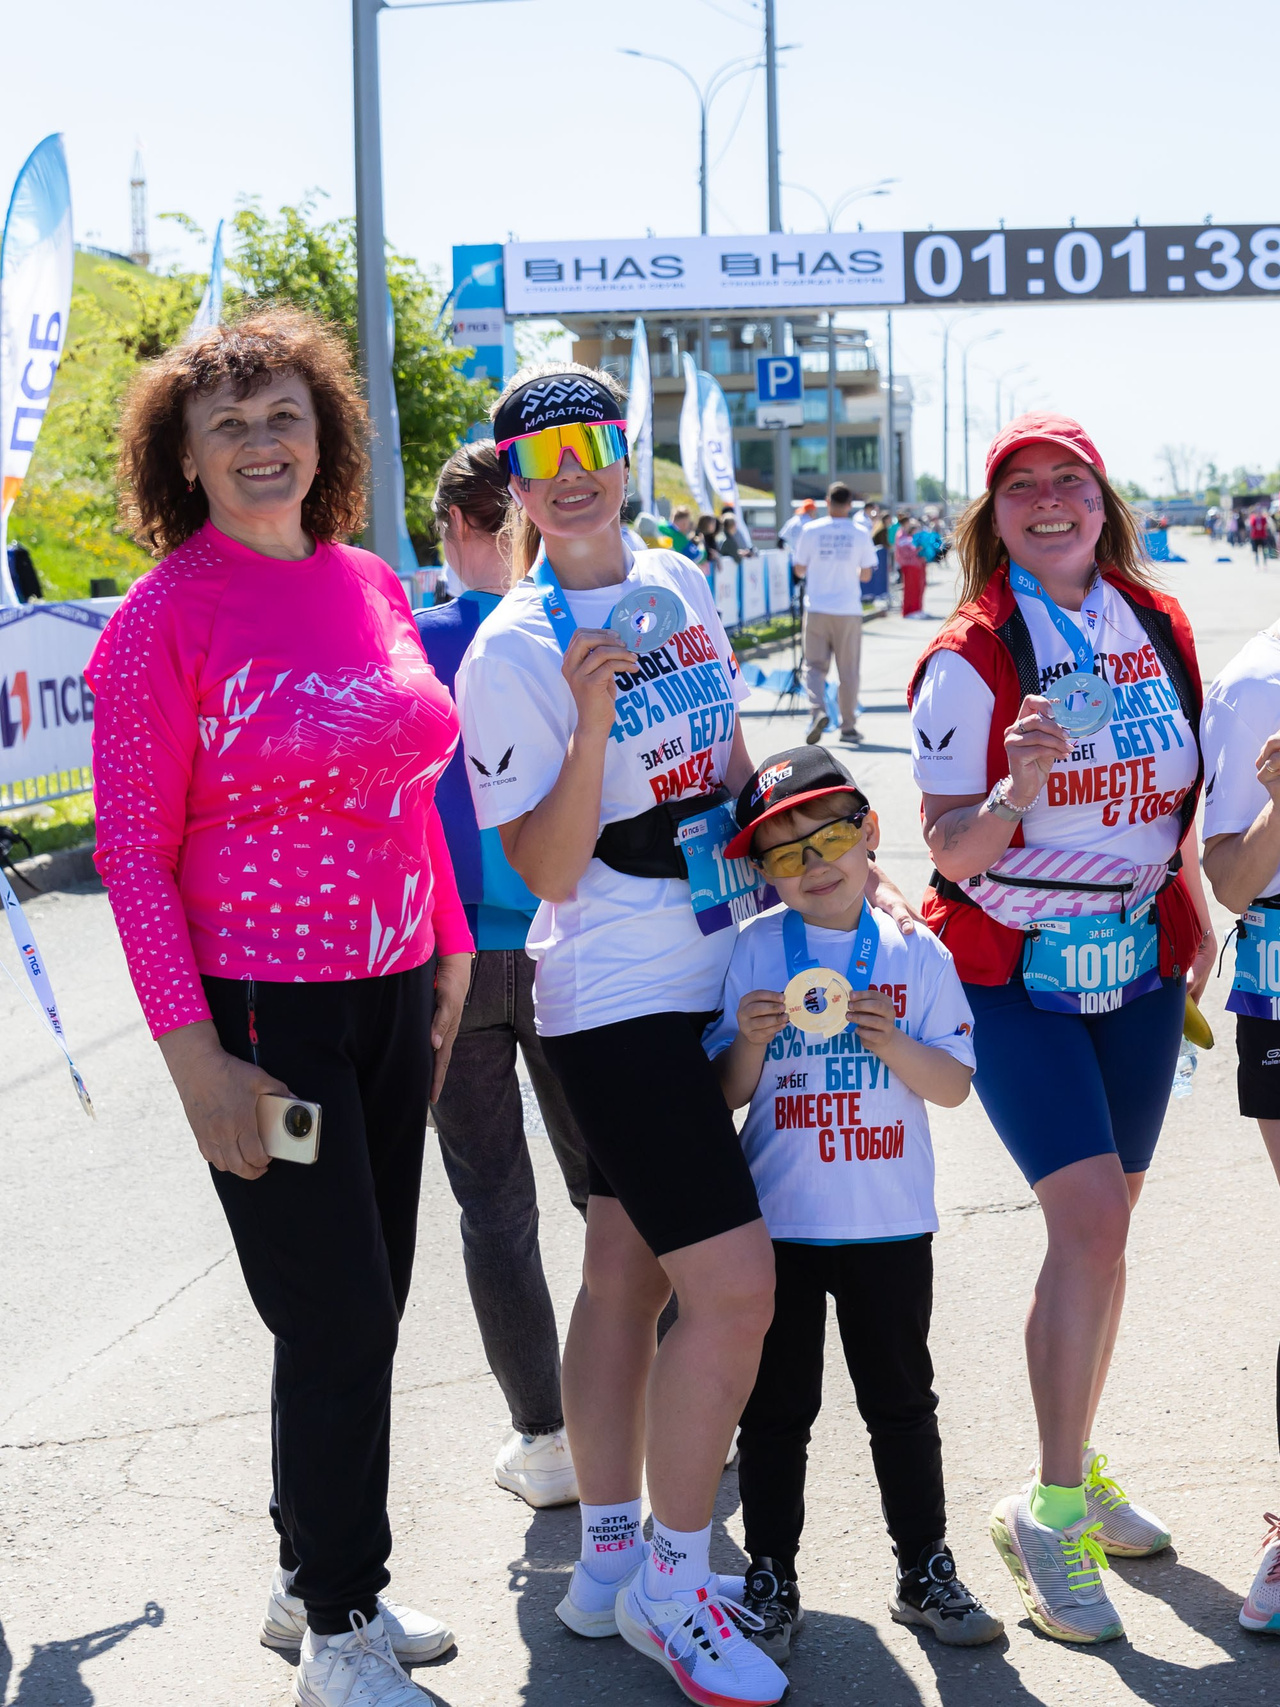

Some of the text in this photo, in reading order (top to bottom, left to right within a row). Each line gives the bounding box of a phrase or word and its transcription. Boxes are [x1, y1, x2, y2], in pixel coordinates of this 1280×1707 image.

[574, 255, 685, 281] HAS
[771, 250, 884, 276] HAS
[10, 312, 61, 453] ПСБ
[768, 361, 794, 396] P
[525, 406, 604, 431] MARATHON
[1109, 714, 1185, 760] БЕГУТ
[493, 776, 518, 787] ГЕРОЕВ
[1046, 756, 1157, 807] ВМЕСТЕ
[1102, 799, 1124, 827] С
[860, 937, 872, 959] ПСБ
[28, 955, 41, 977] ПСБ
[1061, 935, 1136, 989] 1016
[826, 1056, 889, 1092] БЕГУТ
[775, 1092, 862, 1130] ВМЕСТЕ
[819, 1120, 905, 1163] С ТОБОЙ
[587, 1521, 640, 1533] ДЕВОЧКА
[601, 1515, 628, 1525] ЭТА
[593, 1530, 636, 1542] МОЖЕТ
